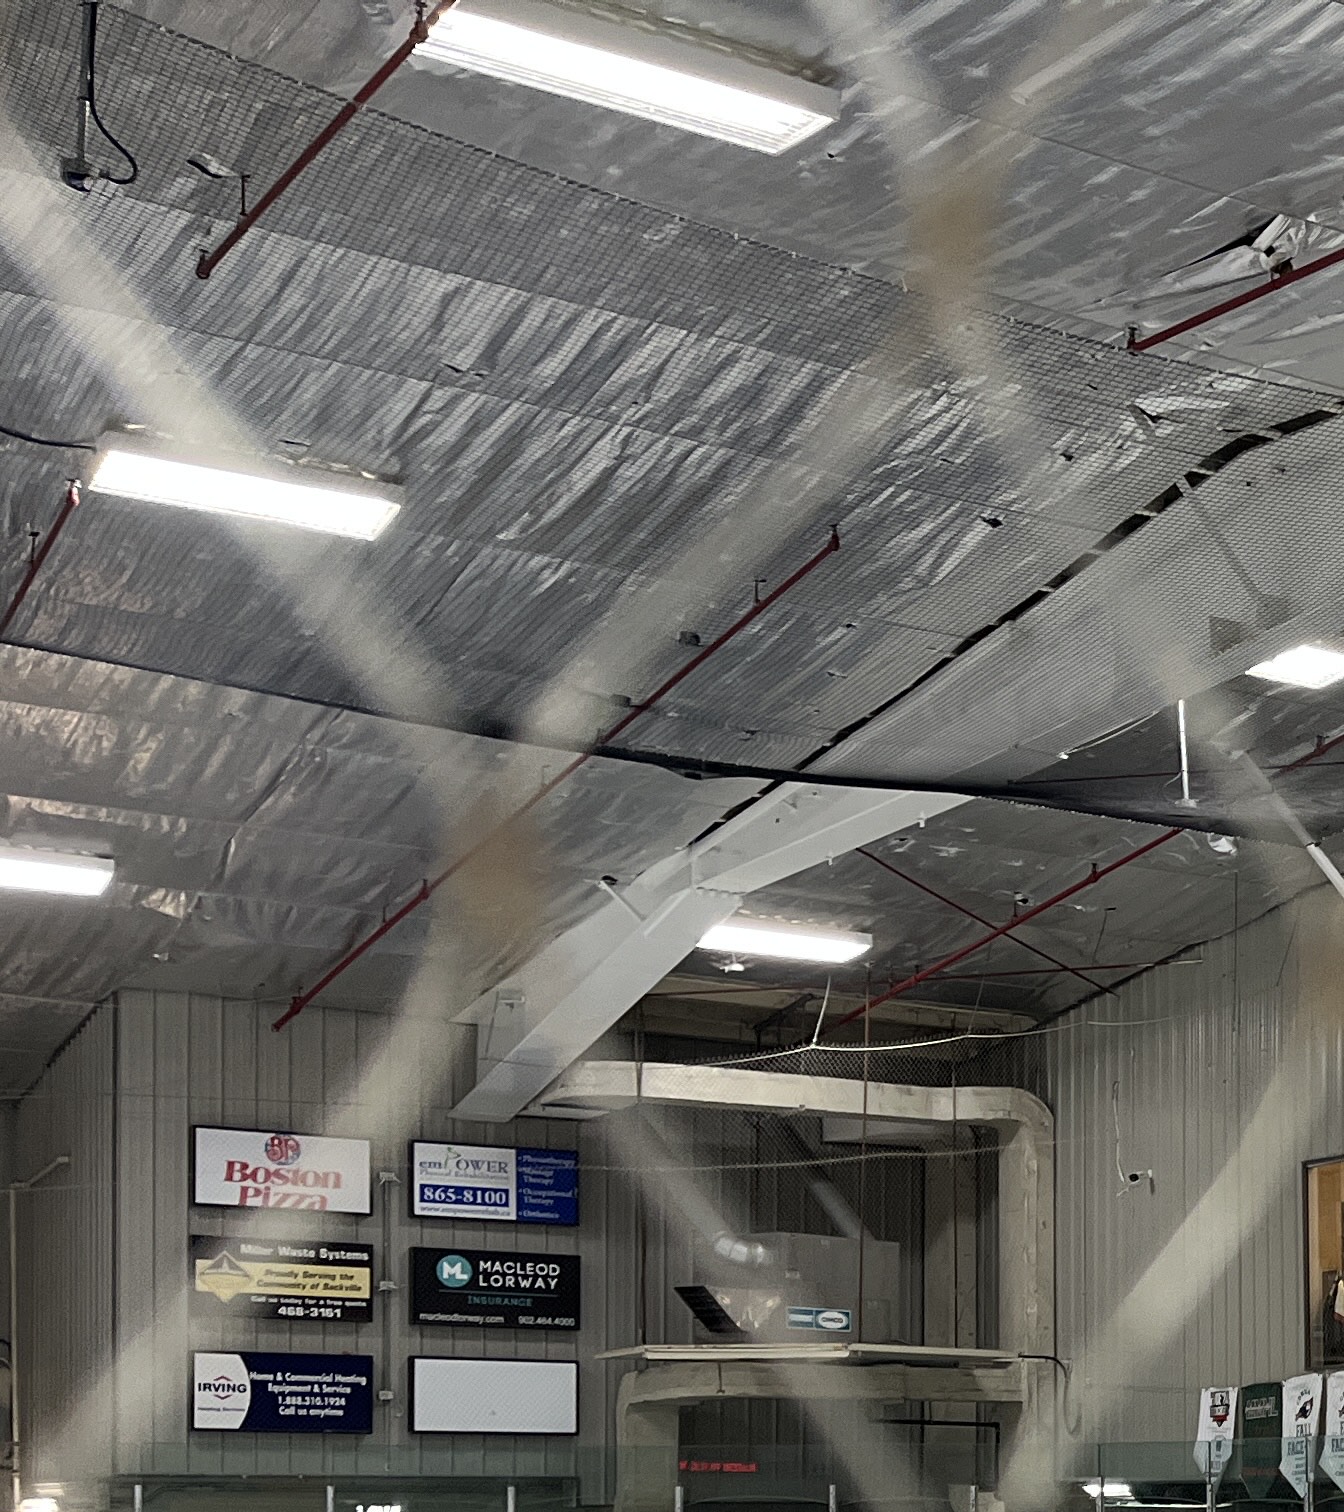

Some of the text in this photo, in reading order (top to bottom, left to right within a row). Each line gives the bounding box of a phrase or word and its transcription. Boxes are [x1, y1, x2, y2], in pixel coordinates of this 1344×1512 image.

[223, 1160, 342, 1189] Boston
[238, 1186, 328, 1211] Pizza
[423, 1187, 507, 1205] 865-8100
[319, 1248, 369, 1261] Systems
[442, 1262, 468, 1279] ML
[479, 1260, 560, 1276] MACLEOD
[302, 1271, 337, 1281] Serving
[479, 1275, 558, 1290] LORWAY
[467, 1295, 533, 1307] INSURANCE
[198, 1383, 247, 1393] IRVING
[268, 1383, 311, 1394] Equipment
[322, 1384, 351, 1393] Service
[279, 1406, 296, 1415] Call
